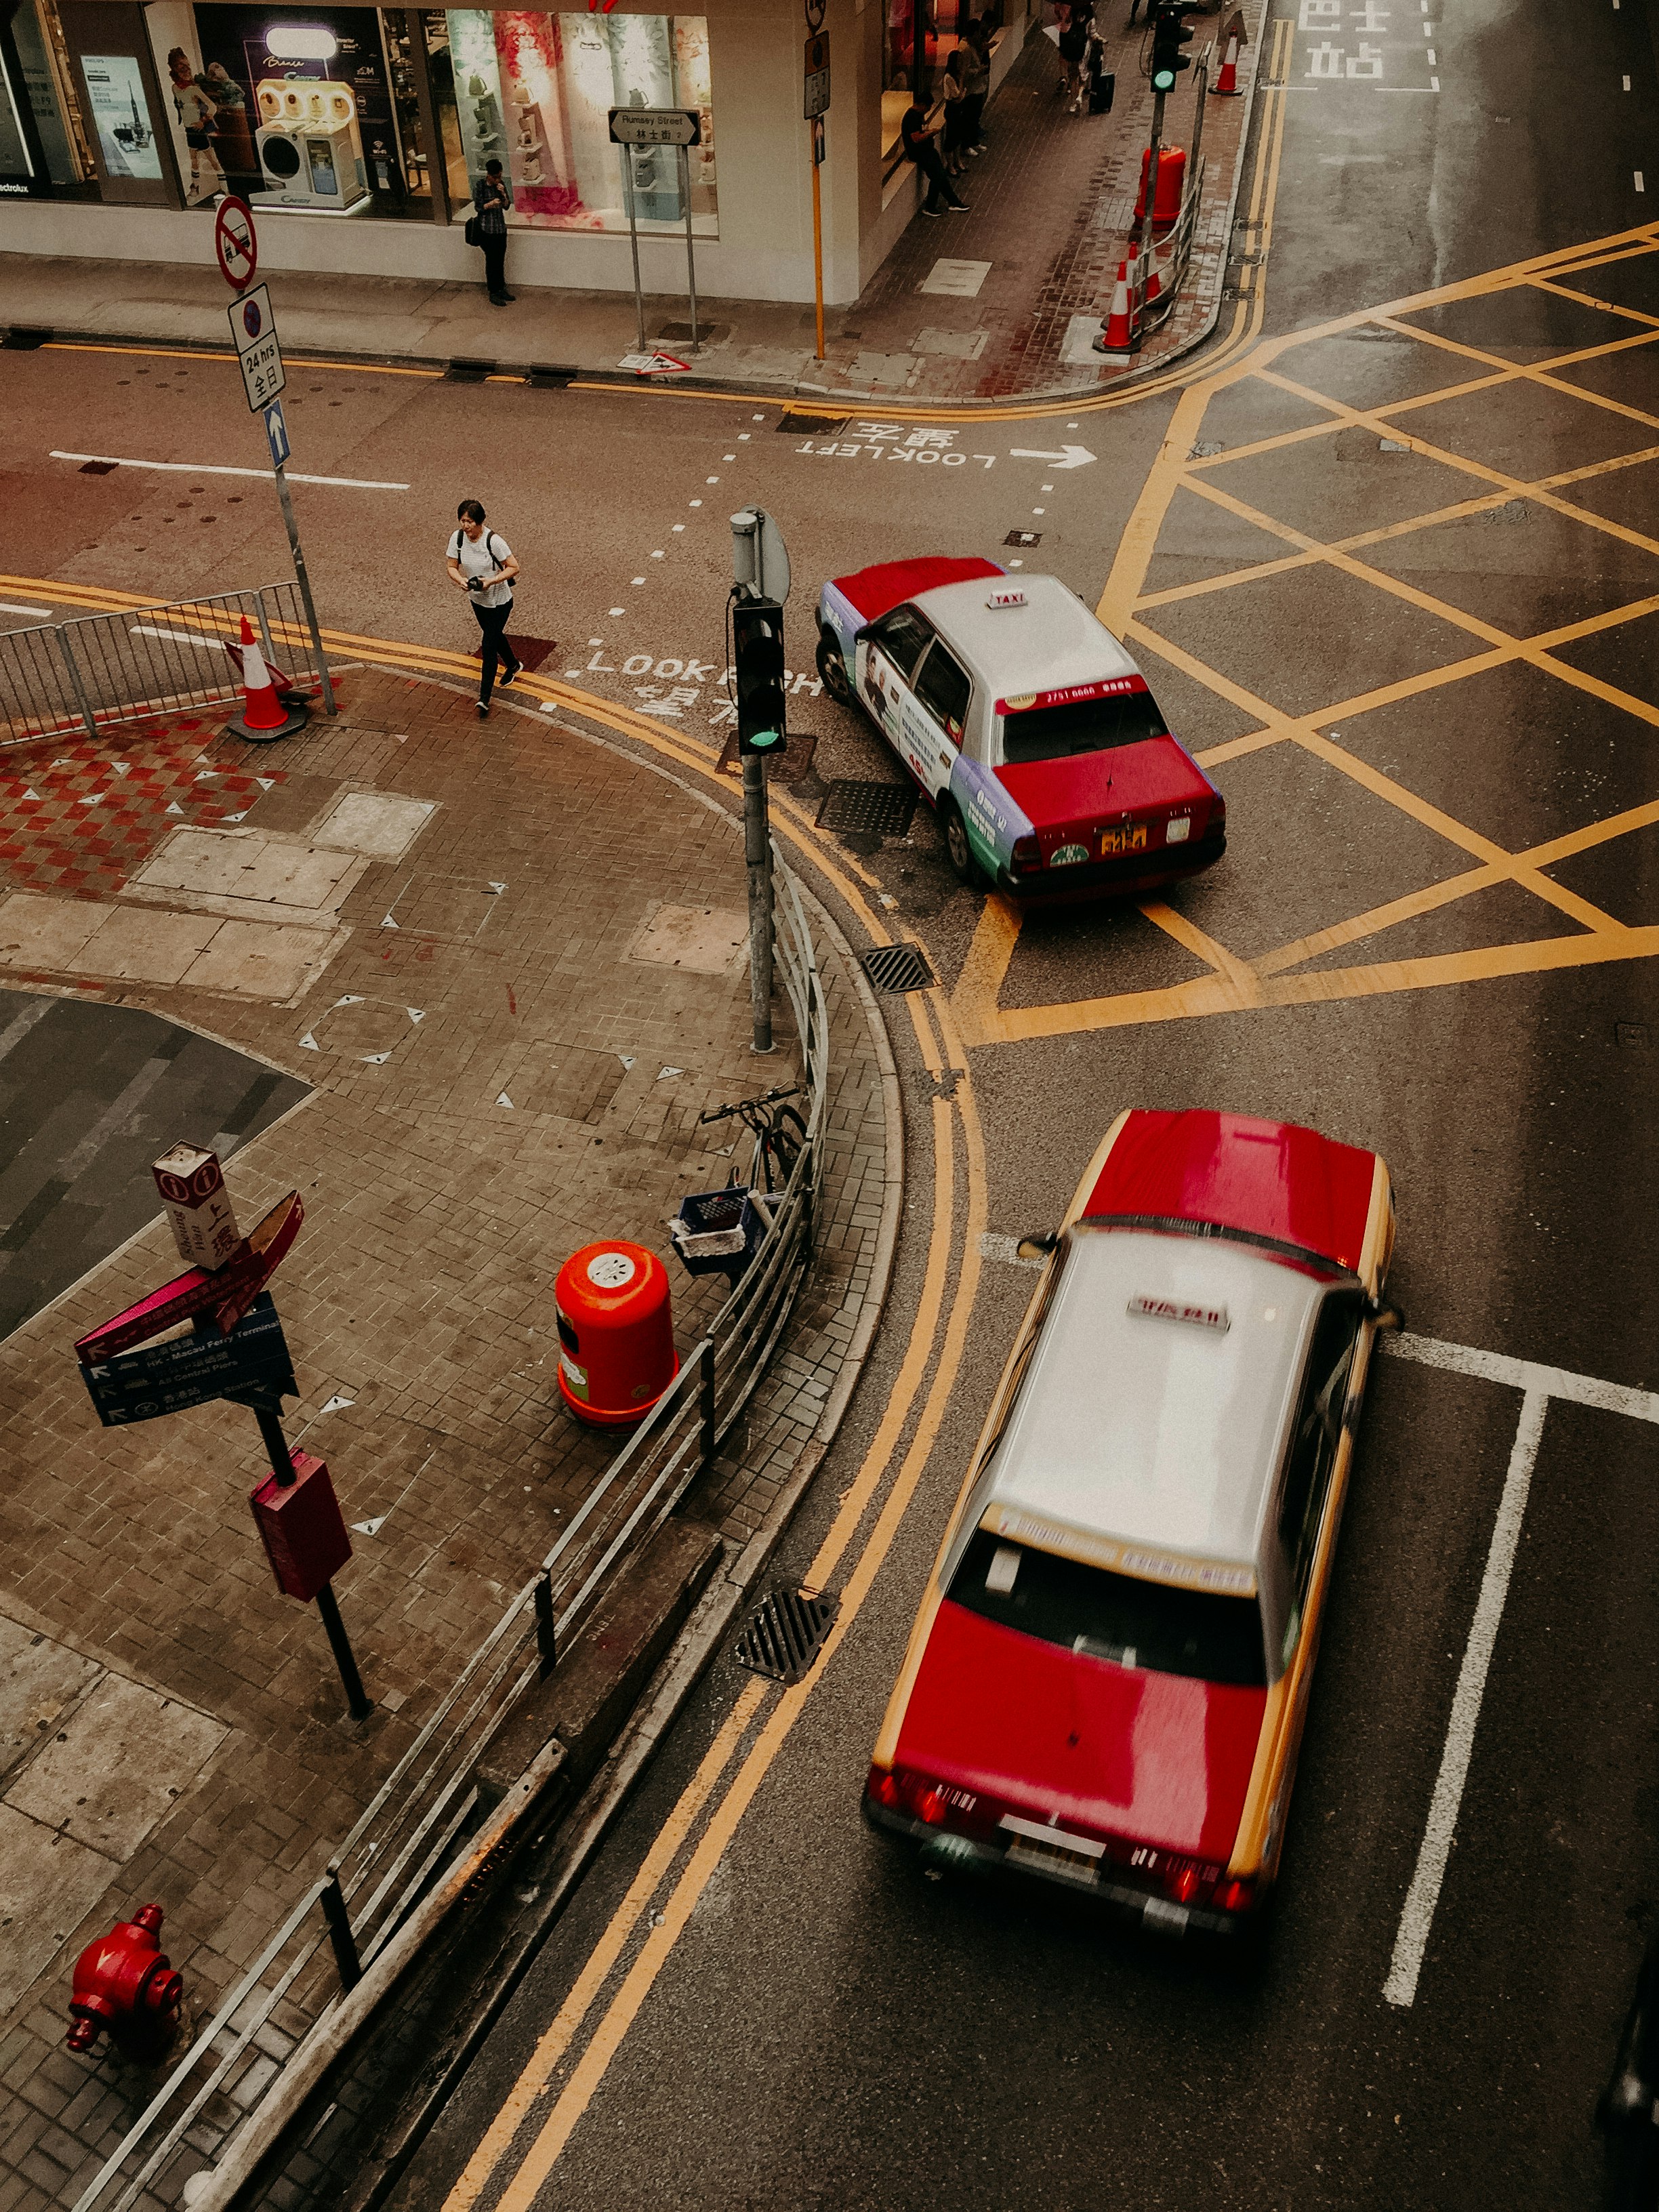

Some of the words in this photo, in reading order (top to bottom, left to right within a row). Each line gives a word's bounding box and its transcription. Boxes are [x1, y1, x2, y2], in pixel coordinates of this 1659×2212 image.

[1298, 0, 1391, 31] 巴士
[1304, 41, 1382, 79] 站
[622, 115, 655, 125] Rumsey
[657, 116, 683, 125] Street
[636, 129, 671, 140] 林士街
[247, 352, 260, 374] 24
[260, 344, 274, 363] hrs
[255, 365, 277, 398] 全日
[795, 441, 884, 459] LEFT
[887, 446, 997, 468] LOOK
[996, 593, 1024, 605] TAXI
[586, 651, 718, 682] LOOK
[173, 1210, 194, 1256] Sheung
[191, 1225, 205, 1250] Wan
[207, 1204, 239, 1257] 上環
[146, 1358, 164, 1368] HK
[171, 1345, 205, 1360] Macau
[207, 1335, 234, 1349] Ferry
[236, 1321, 280, 1338] Terminal
[173, 1367, 211, 1382] Central
[213, 1360, 238, 1370] Piers
[195, 1391, 223, 1404] Kong
[224, 1378, 261, 1394] Station
